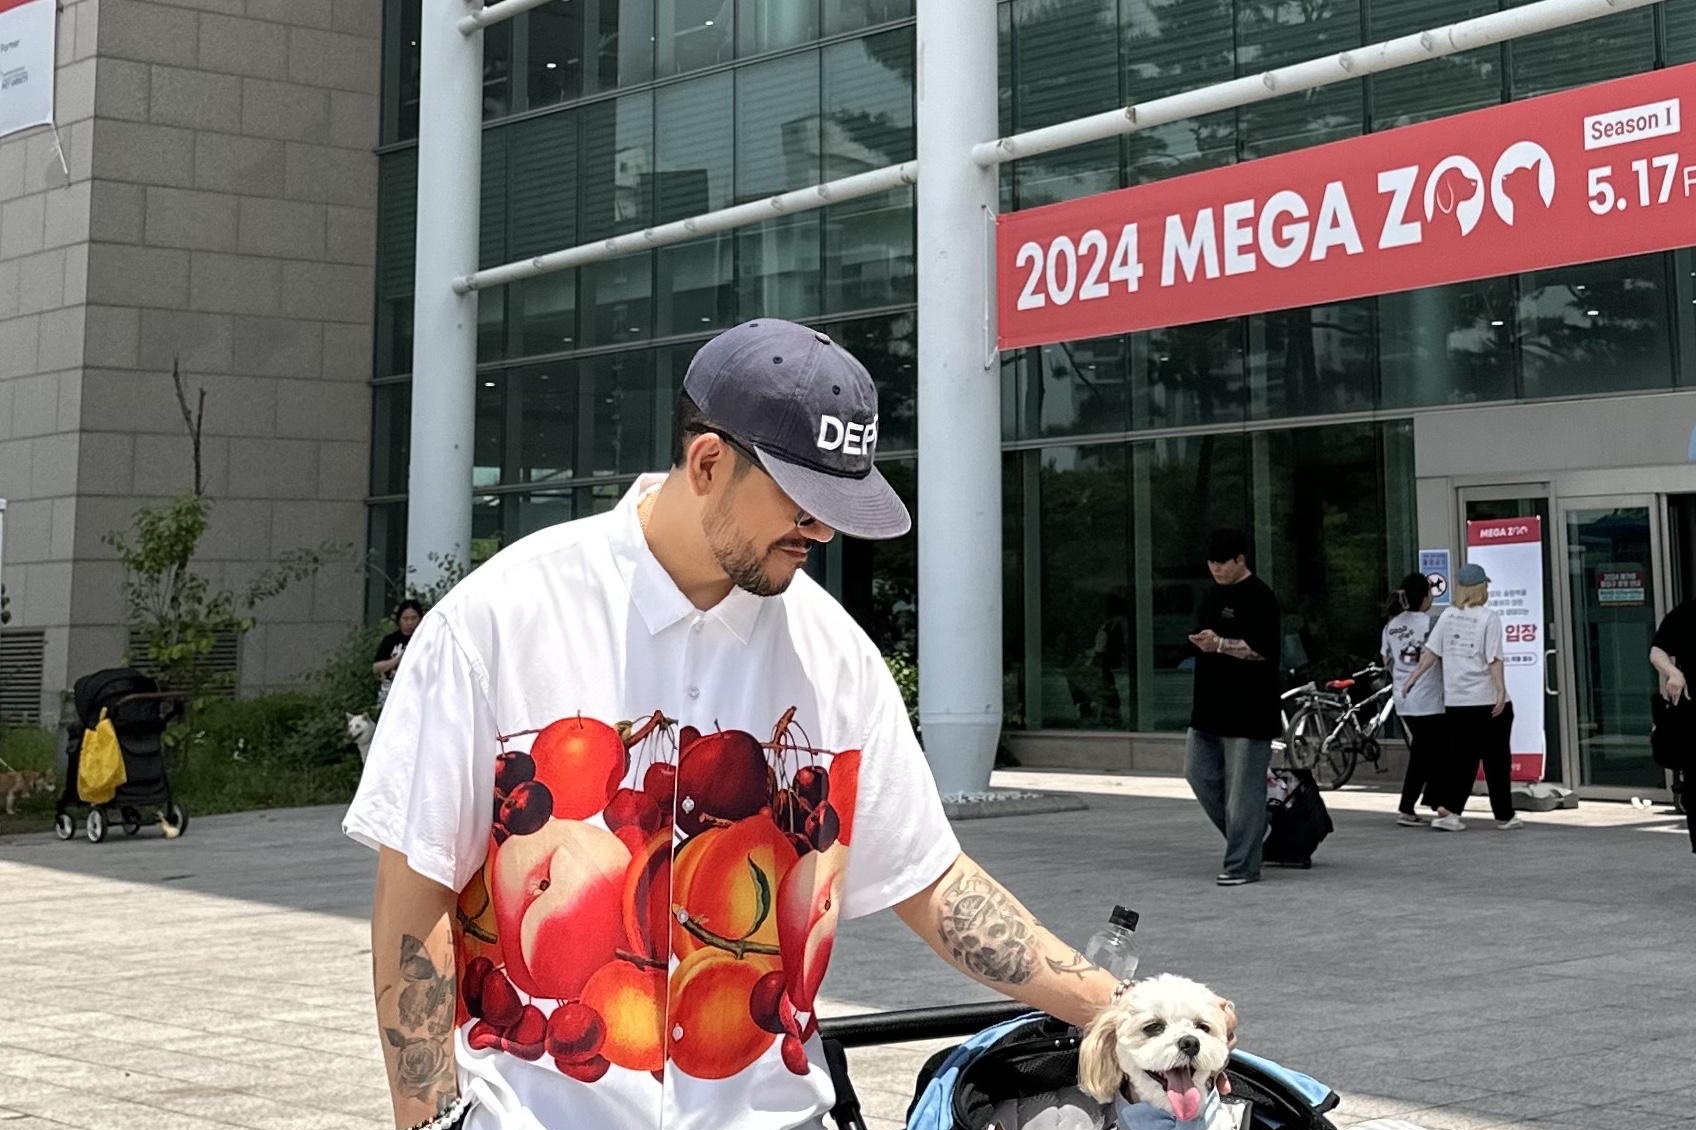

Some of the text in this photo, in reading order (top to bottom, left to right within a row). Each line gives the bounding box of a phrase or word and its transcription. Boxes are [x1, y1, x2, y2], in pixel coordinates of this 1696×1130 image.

[1591, 113, 1659, 141] Season
[1587, 152, 1679, 215] 5.17
[1015, 140, 1556, 311] 2024 MEGA ZOO
[1480, 527, 1507, 539] MEGA
[1505, 624, 1538, 643] 입장
